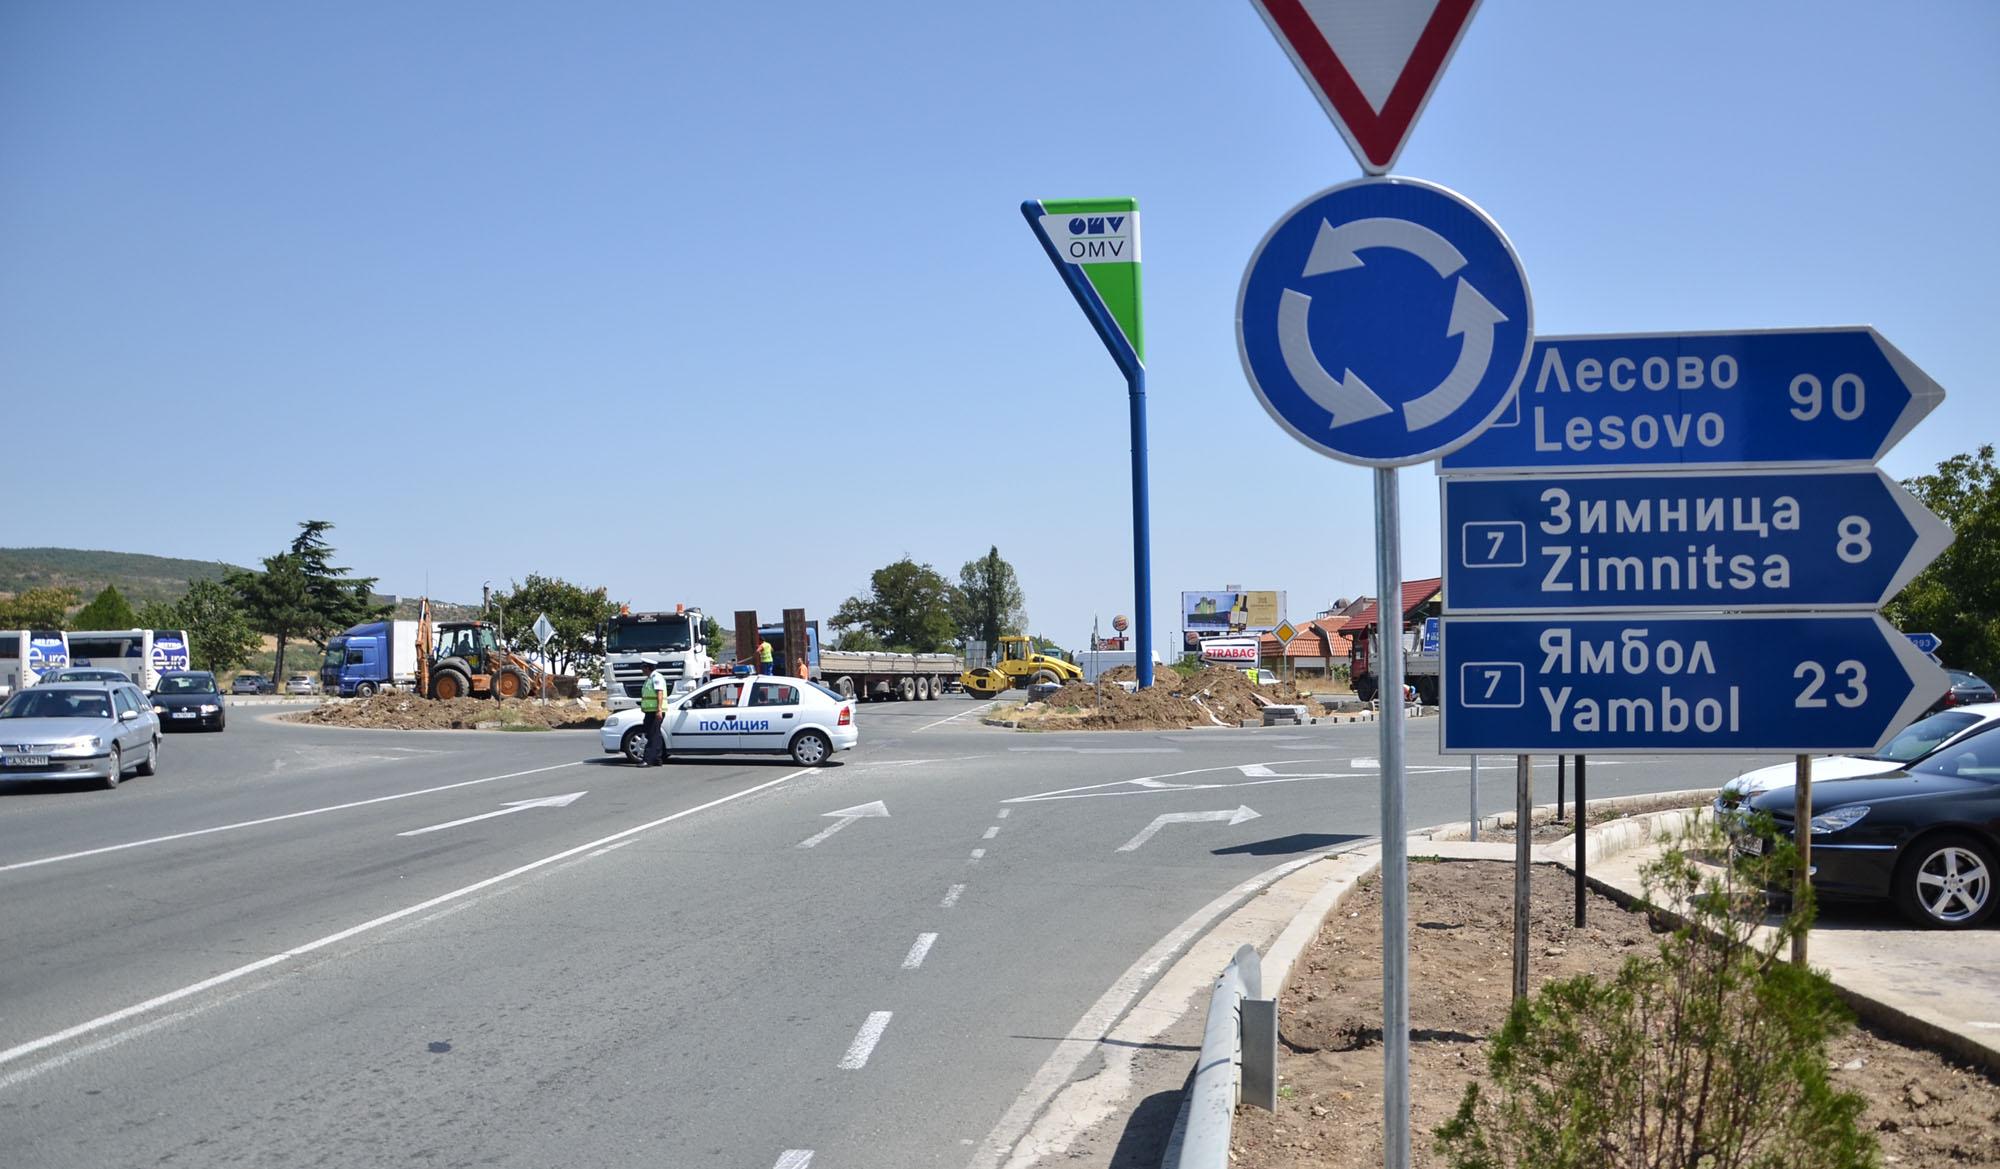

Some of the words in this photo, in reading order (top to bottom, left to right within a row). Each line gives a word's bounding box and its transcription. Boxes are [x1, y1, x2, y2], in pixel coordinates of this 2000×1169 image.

[1069, 241, 1124, 258] OMV
[1535, 348, 1739, 393] Лесово
[1790, 374, 1865, 421] 90
[1534, 406, 1725, 451] Lesovo
[1540, 487, 1801, 538] Зимница
[1487, 531, 1504, 559] 7
[1836, 515, 1872, 563] 8
[1540, 544, 1791, 592] Zimnitsa
[1205, 648, 1256, 658] STRABAG
[1539, 628, 1716, 675] Ямбол
[1484, 670, 1501, 698] 7
[1793, 660, 1868, 708] 23
[699, 720, 769, 733] ПОЛИЦИЯ
[1539, 686, 1739, 733] Yambol
